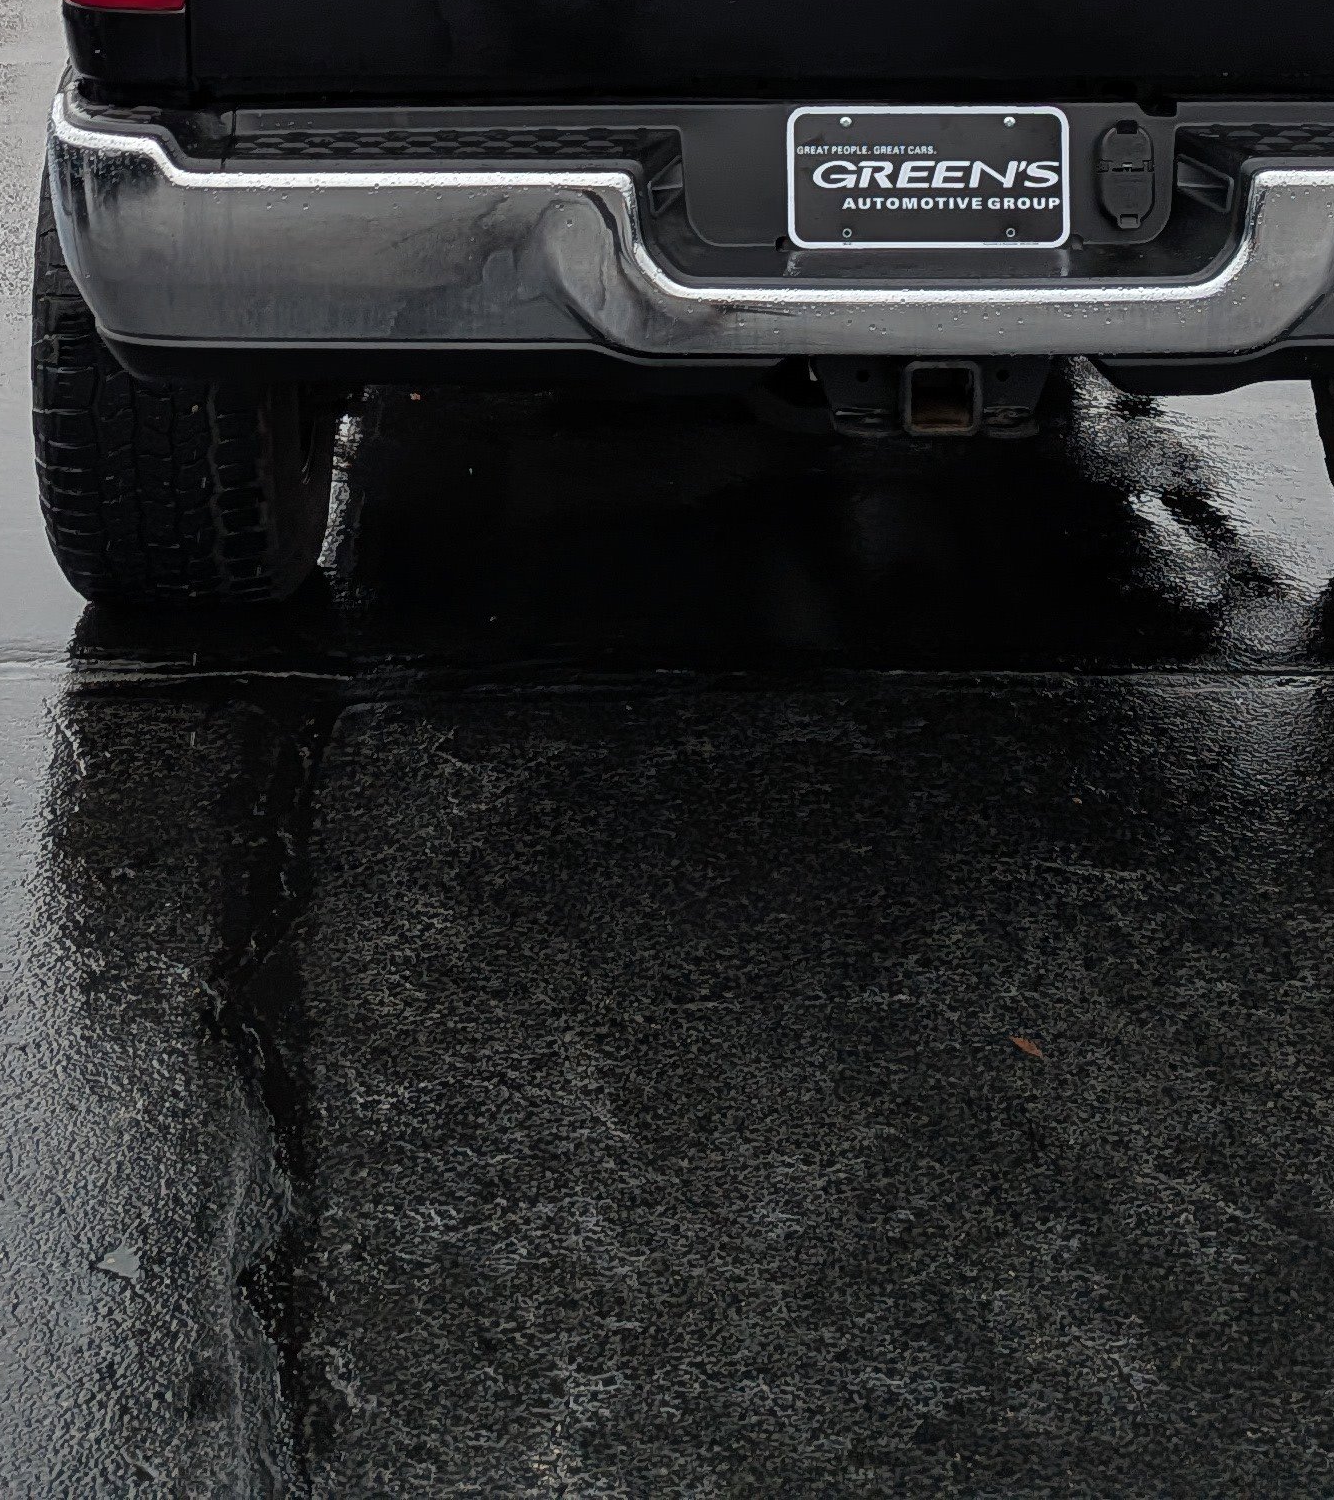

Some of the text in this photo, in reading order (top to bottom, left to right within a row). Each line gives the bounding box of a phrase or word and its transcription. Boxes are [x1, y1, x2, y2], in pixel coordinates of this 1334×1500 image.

[796, 145, 937, 155] GREAT PEOPLE. GREAT CARS.
[812, 160, 1060, 189] GREEN'S
[842, 197, 1061, 210] AUTOMOTIVE GROUP
